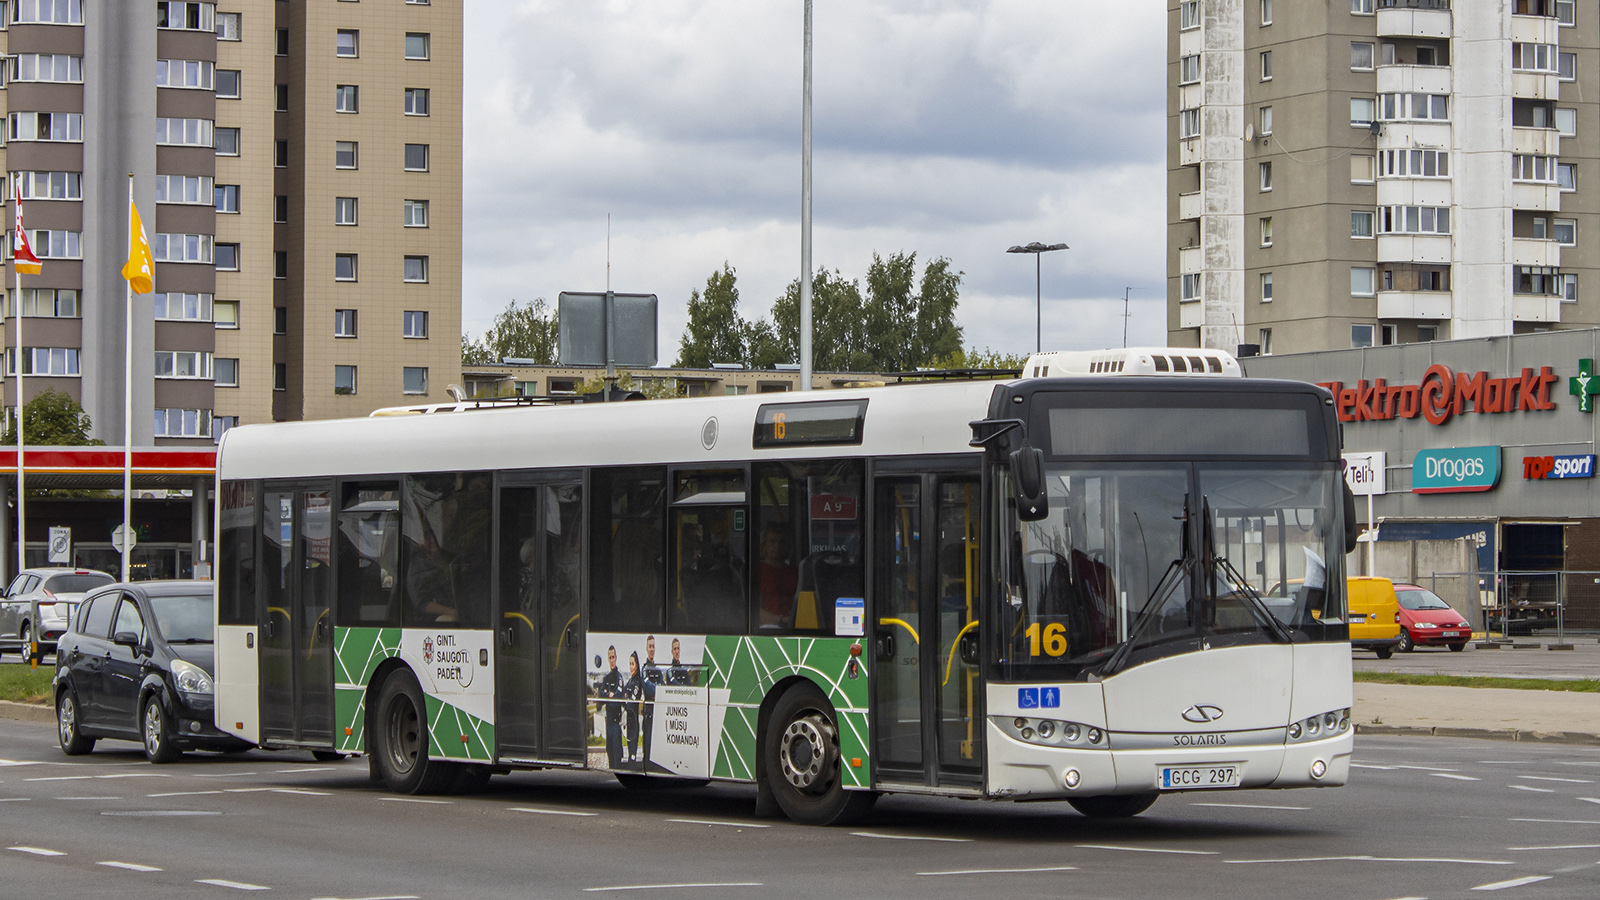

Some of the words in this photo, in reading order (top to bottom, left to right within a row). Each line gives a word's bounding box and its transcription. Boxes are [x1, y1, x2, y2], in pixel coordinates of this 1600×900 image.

[1315, 378, 1418, 422] lektro
[772, 412, 786, 440] 16
[1425, 456, 1485, 482] Drogas
[436, 634, 457, 647] GINTI.
[1025, 622, 1068, 657] 16
[436, 651, 470, 664] SAUGOTI.
[437, 665, 464, 680] PADĖTI.
[665, 706, 688, 717] JUNKIS
[669, 718, 688, 734] MŪSŲ
[666, 733, 700, 749] KOMANDĄ!
[1173, 734, 1227, 747] SOLARIS
[1172, 769, 1201, 785] GCG
[1209, 768, 1233, 784] 297
